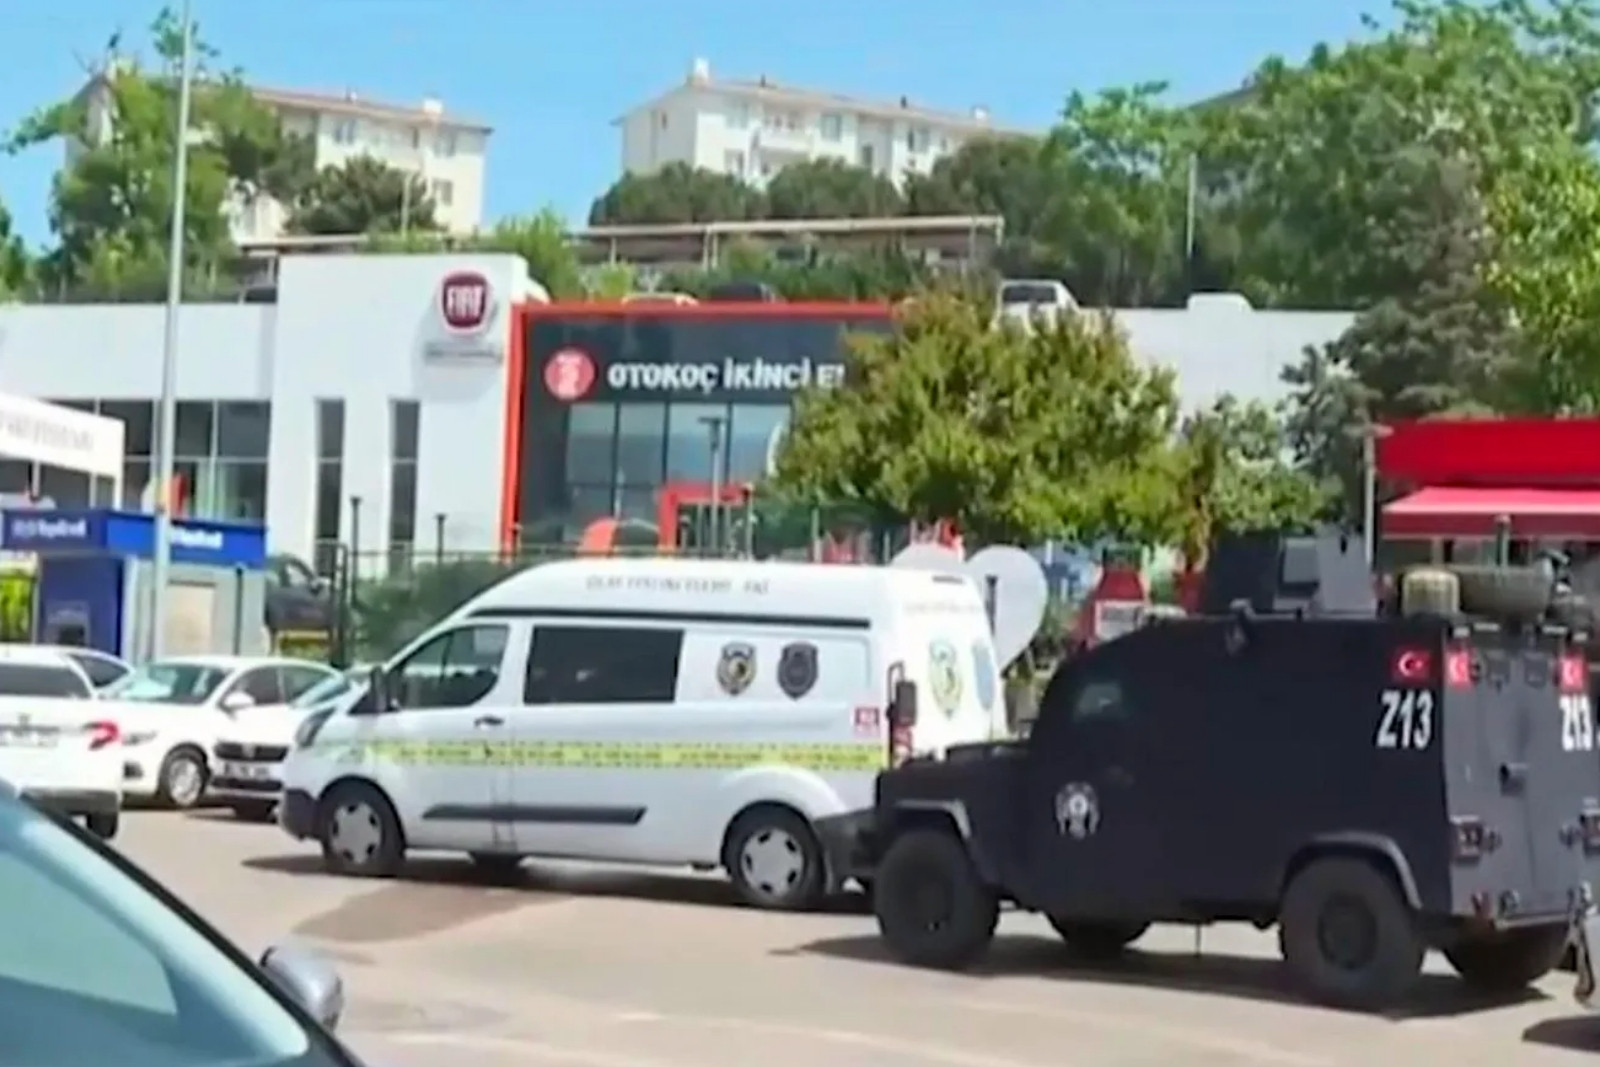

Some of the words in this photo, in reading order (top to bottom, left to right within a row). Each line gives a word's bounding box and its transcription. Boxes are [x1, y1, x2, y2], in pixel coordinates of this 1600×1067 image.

[607, 362, 719, 393] OTOKOÇ
[723, 356, 811, 388] İKİNCİ
[1376, 689, 1433, 749] Z13
